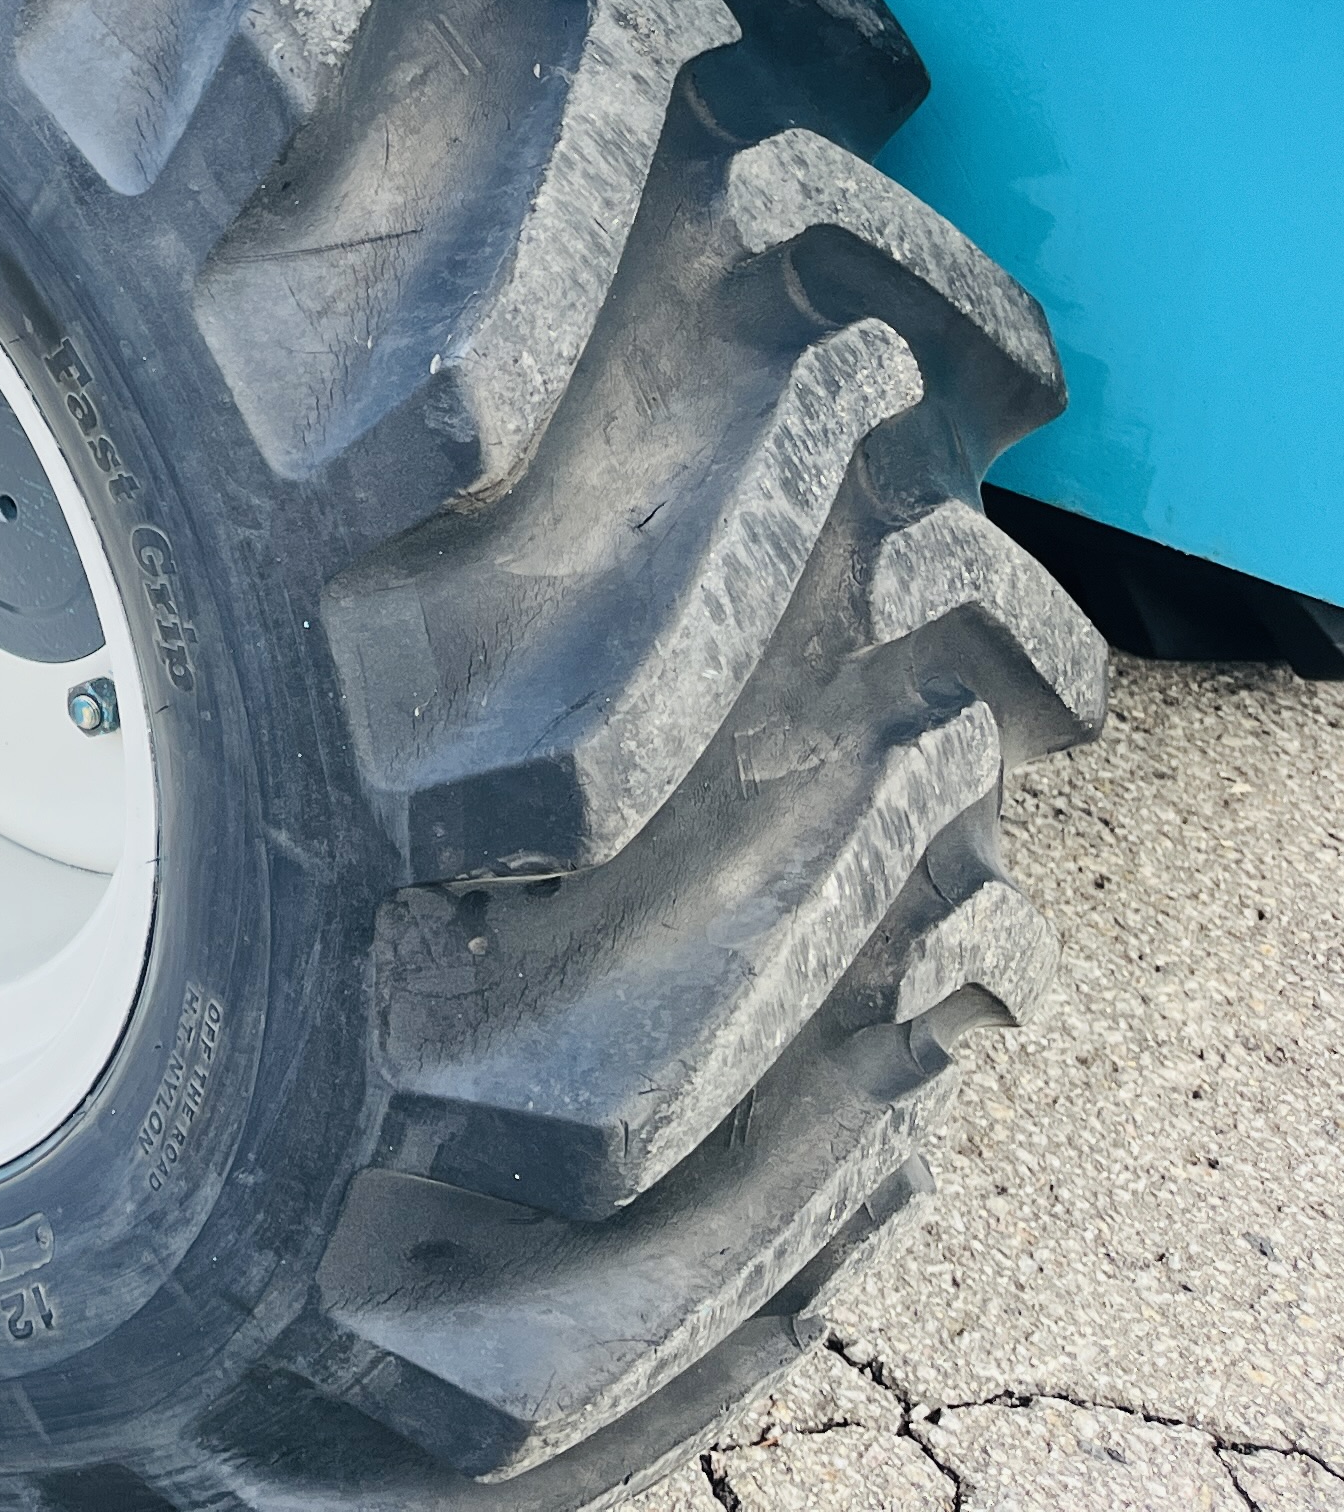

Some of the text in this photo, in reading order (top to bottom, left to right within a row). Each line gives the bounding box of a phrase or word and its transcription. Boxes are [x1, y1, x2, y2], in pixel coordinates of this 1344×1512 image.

[42, 337, 199, 692] Fast Grip
[138, 1054, 184, 1156] NYLON
[148, 1001, 222, 1192] OFF THE ROAD
